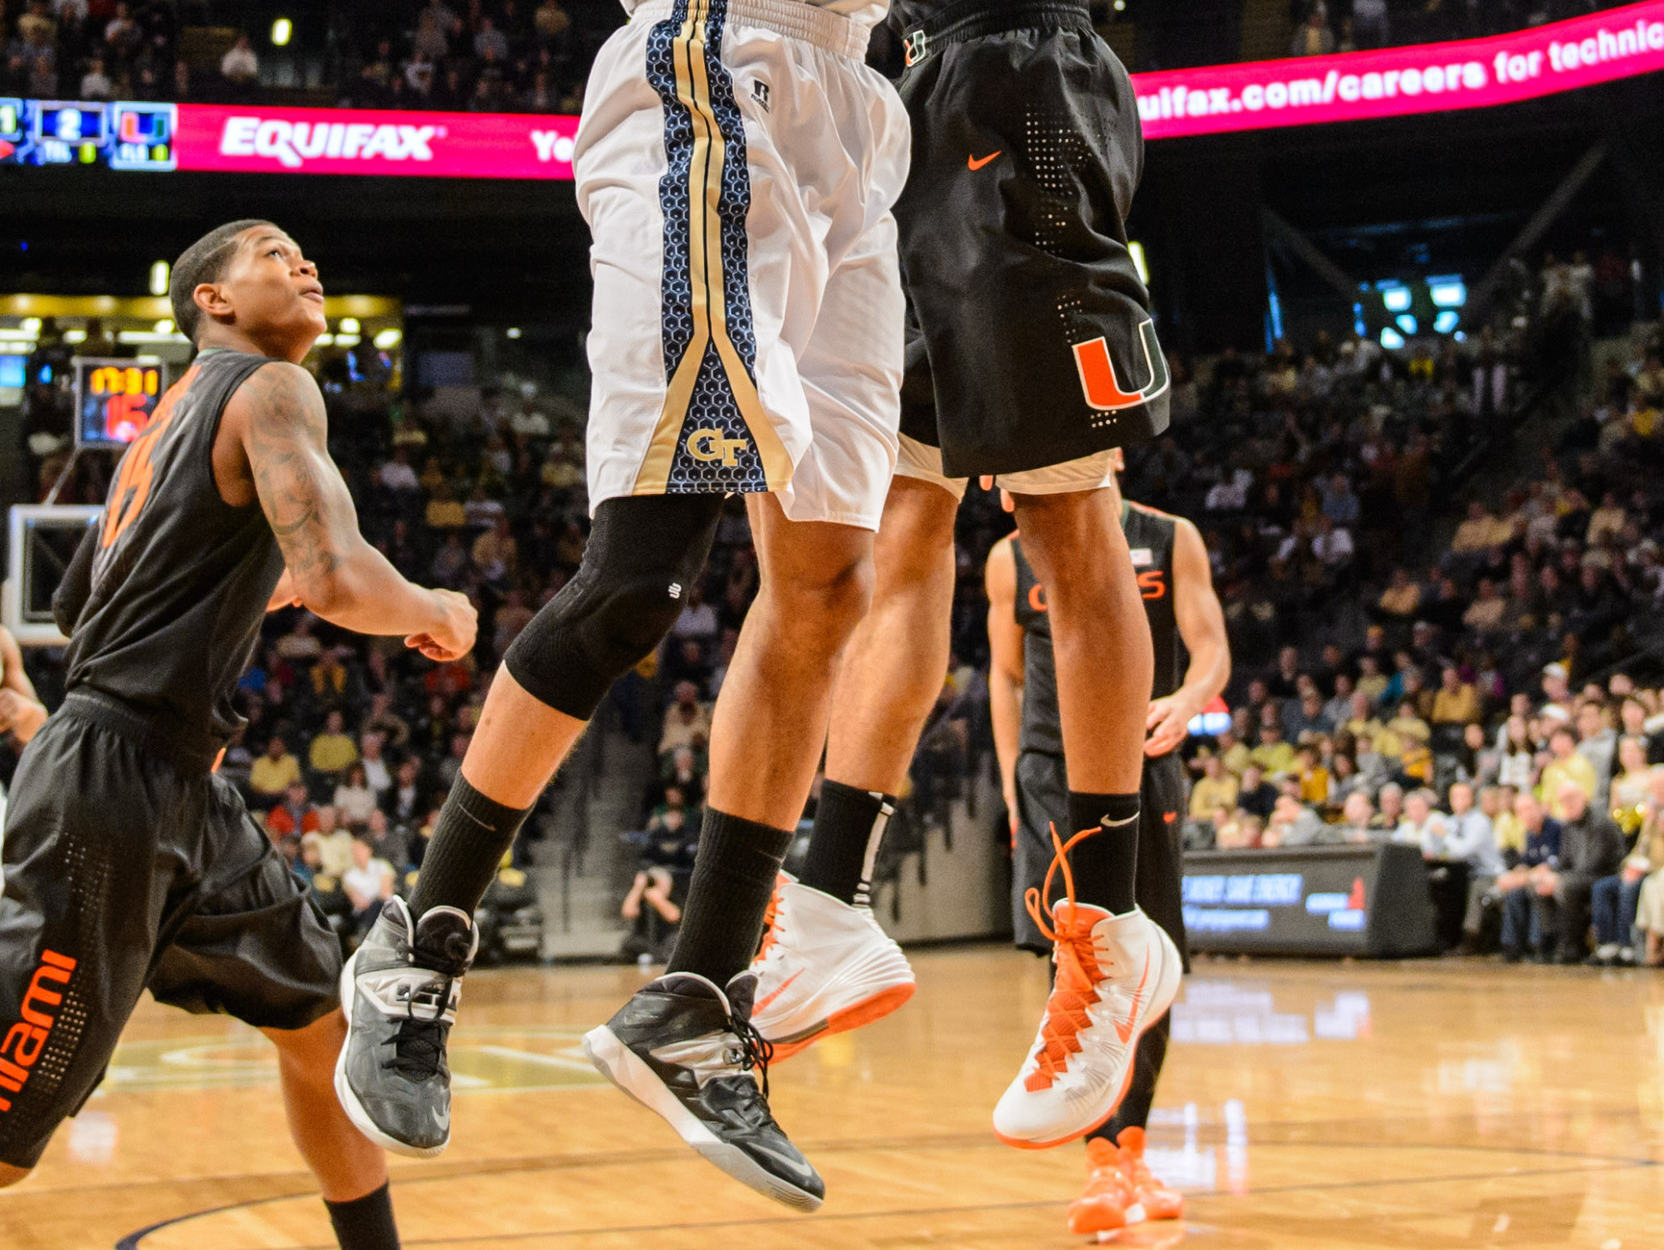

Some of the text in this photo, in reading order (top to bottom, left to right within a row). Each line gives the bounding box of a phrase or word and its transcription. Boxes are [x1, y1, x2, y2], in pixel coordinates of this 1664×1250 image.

[1138, 20, 1664, 122] uifax.com/careers for technic
[56, 108, 82, 141] 2
[220, 116, 437, 168] EQUIFAX
[530, 130, 576, 162] Yo
[1071, 319, 1170, 411] U
[686, 427, 748, 467] GT
